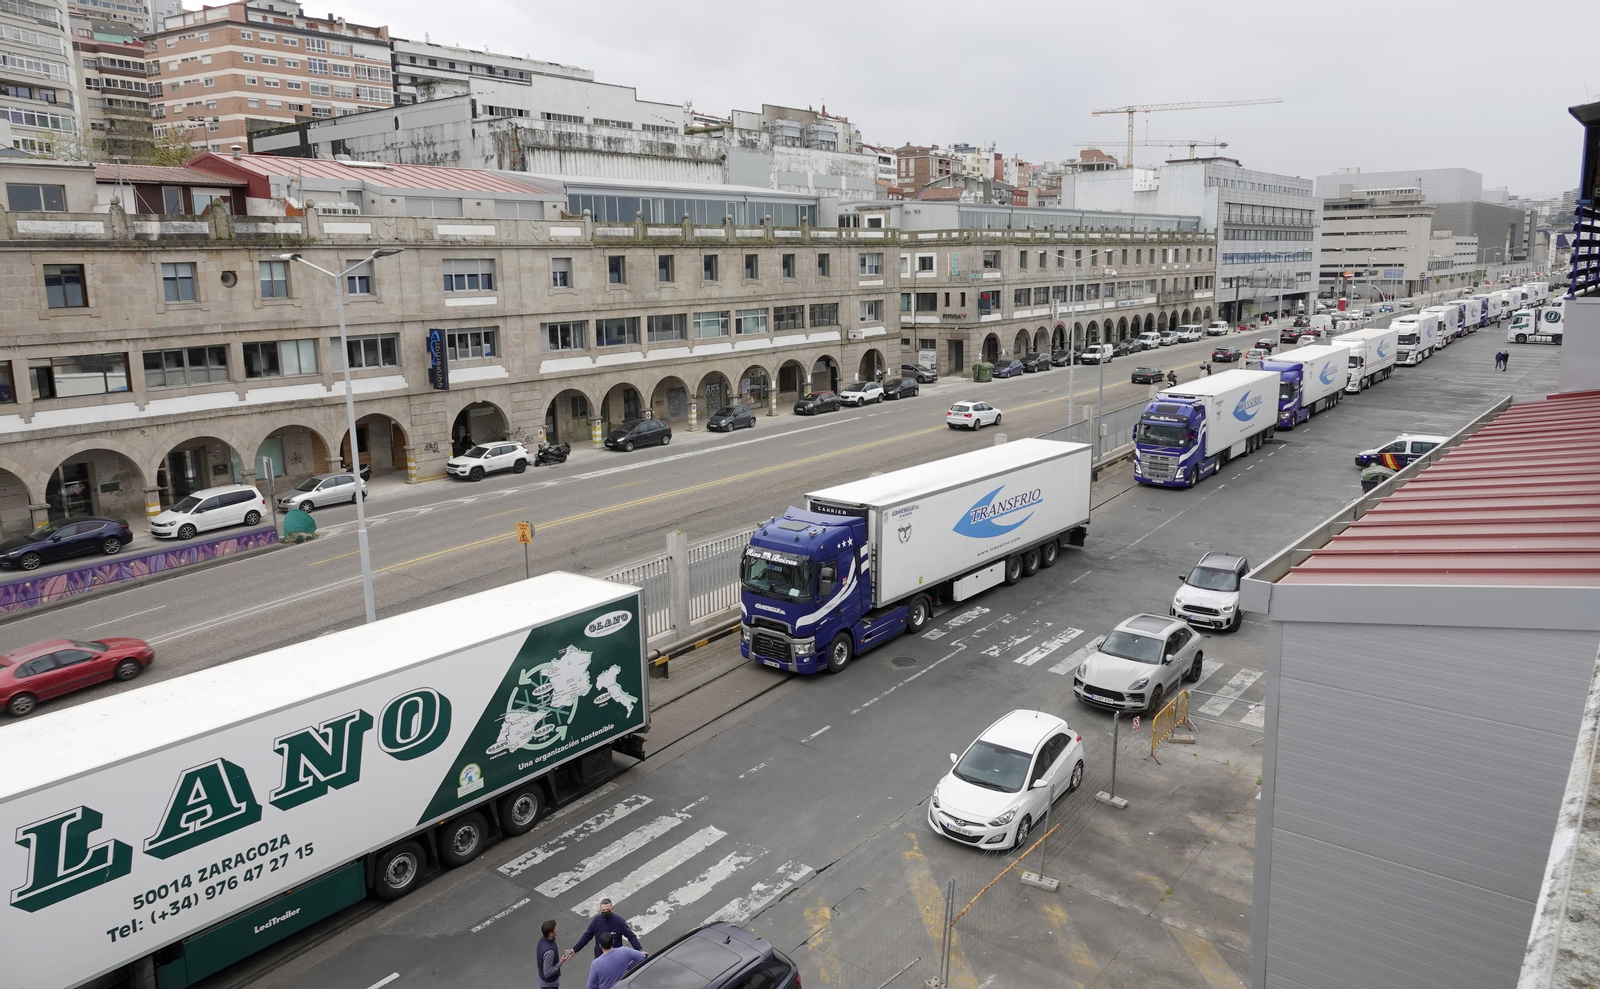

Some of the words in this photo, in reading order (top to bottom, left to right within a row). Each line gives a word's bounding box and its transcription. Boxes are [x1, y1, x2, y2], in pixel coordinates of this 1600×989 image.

[817, 506, 847, 515] CARRIER
[971, 488, 1041, 524] TRANSFRIO
[976, 537, 1021, 557] www.transfrio.com
[588, 613, 628, 632] OLANO
[518, 759, 533, 771] Una
[534, 739, 580, 764] organización
[580, 723, 614, 743] sostenible
[132, 874, 193, 910] 50014
[197, 833, 291, 883] ZARAGOZA
[106, 918, 144, 943] Tel:
[150, 893, 199, 924] (+34)
[204, 875, 238, 901] 976
[243, 864, 264, 883] 47
[269, 853, 289, 873] 27
[294, 842, 314, 861] 15
[253, 907, 301, 934] LeciTrailer
